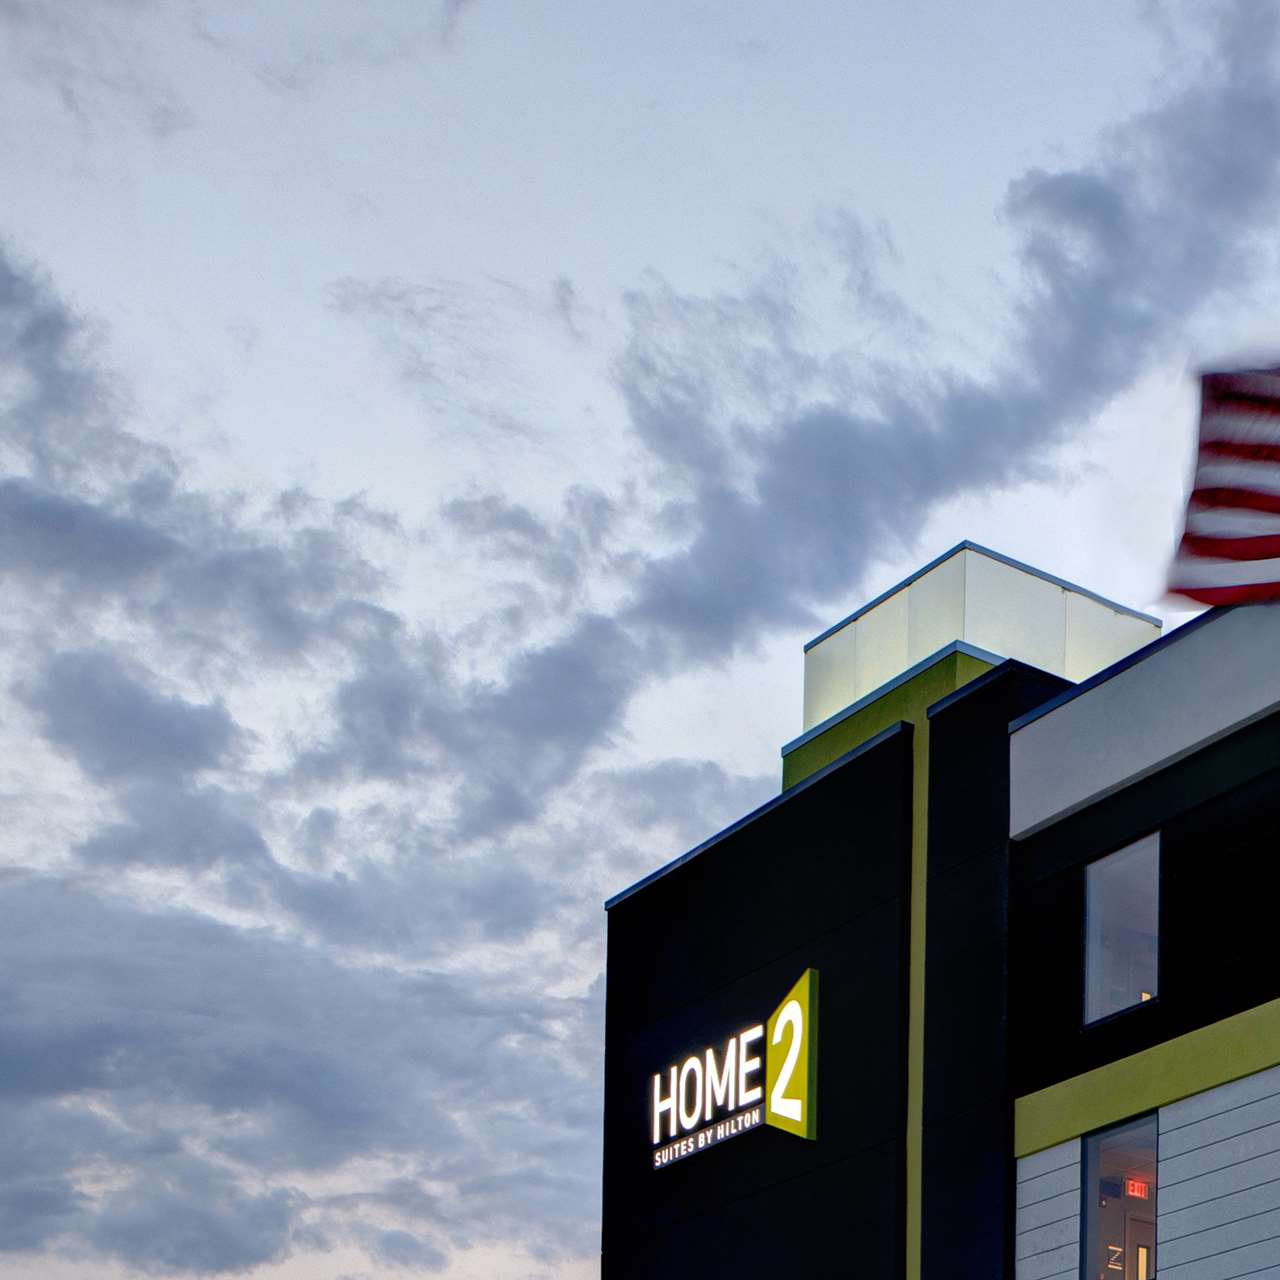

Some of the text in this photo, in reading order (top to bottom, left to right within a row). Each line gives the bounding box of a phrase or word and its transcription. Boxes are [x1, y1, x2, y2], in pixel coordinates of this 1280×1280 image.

[653, 1024, 763, 1144] HOME
[655, 1108, 760, 1167] SUITES BY HILTON
[1128, 1180, 1146, 1199] EXIT
